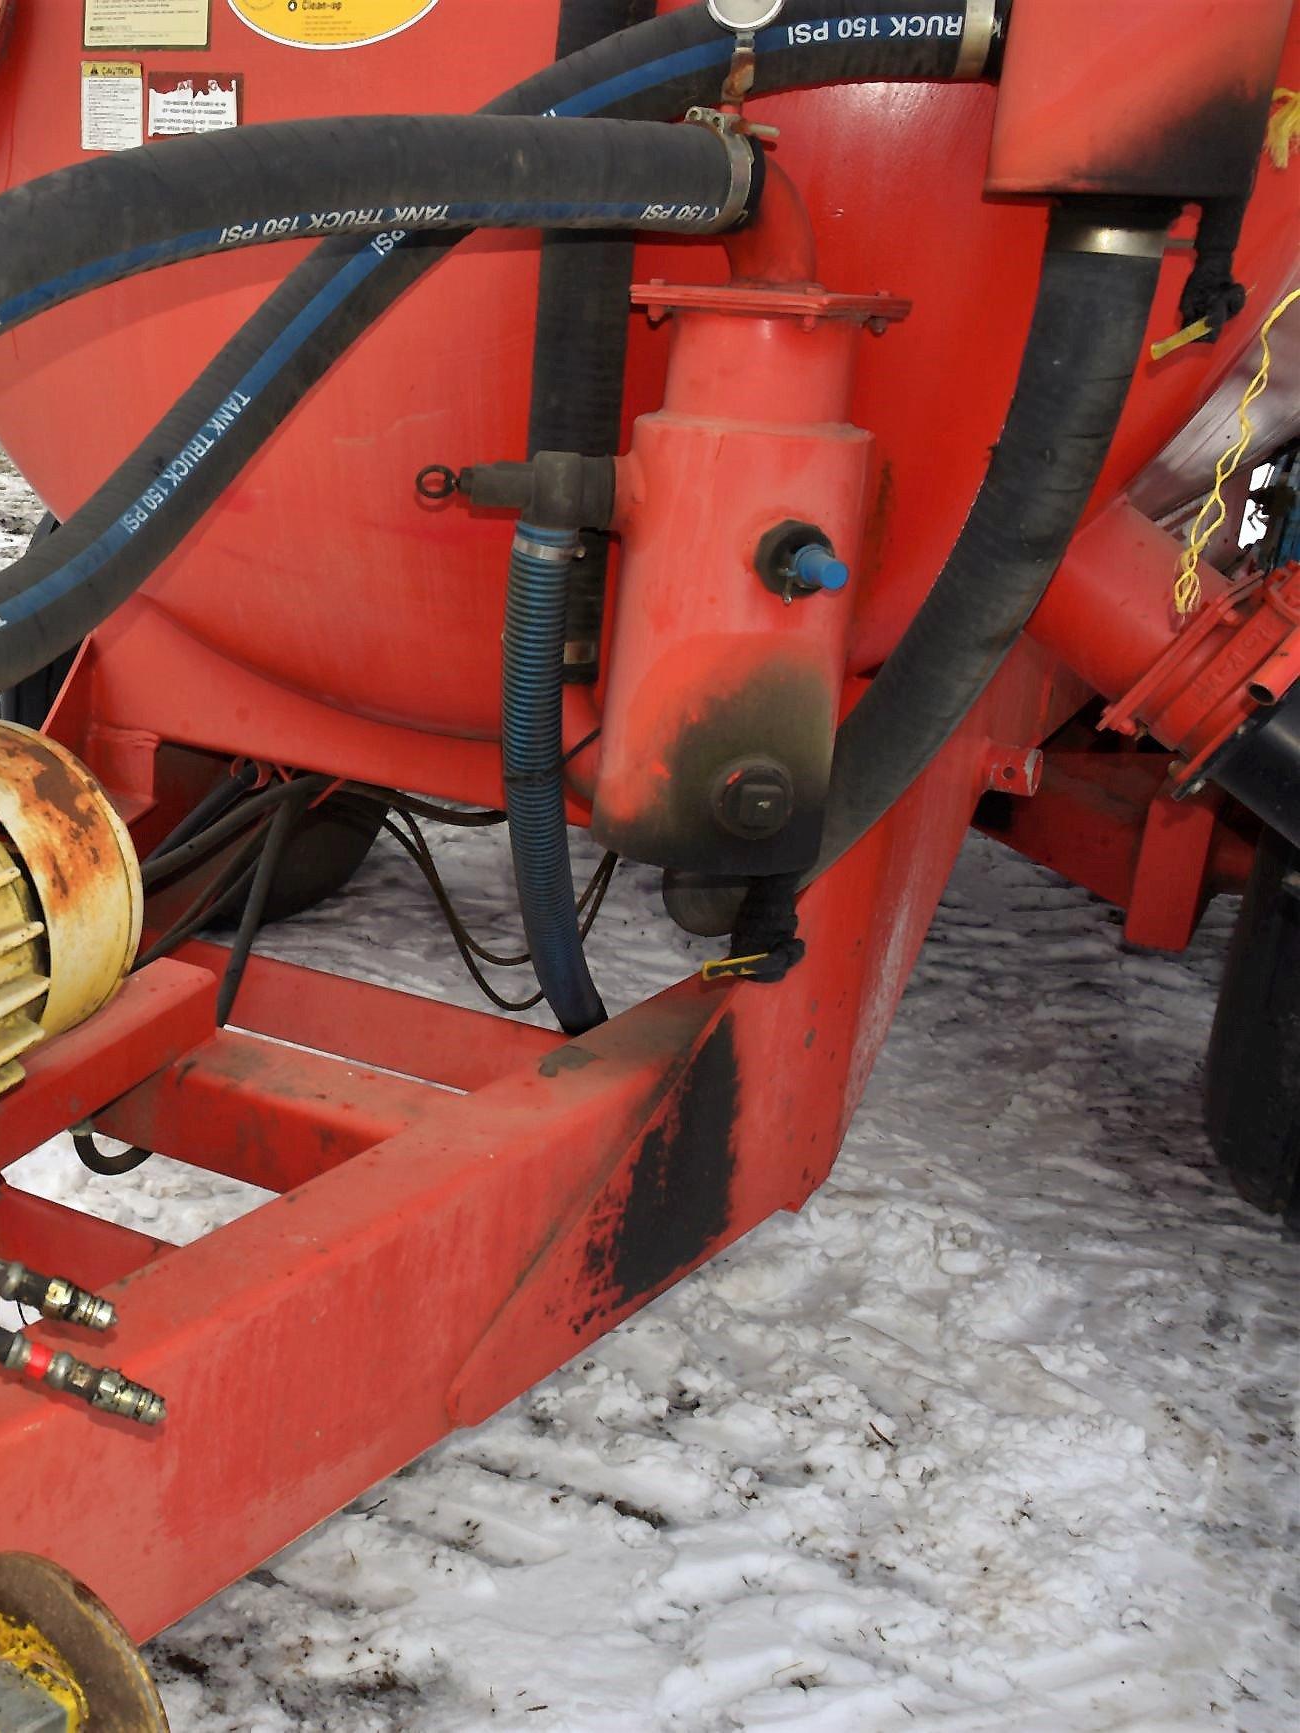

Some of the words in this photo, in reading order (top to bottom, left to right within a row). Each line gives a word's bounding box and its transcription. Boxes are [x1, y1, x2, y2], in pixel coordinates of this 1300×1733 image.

[787, 21, 829, 45] PSI
[838, 17, 880, 39] 150
[889, 15, 963, 37] RUCK
[307, 208, 384, 229] TRUCK
[389, 204, 450, 223] TANK
[640, 204, 676, 220] PSI
[676, 205, 707, 220] 150
[219, 222, 259, 245] PSI
[262, 215, 300, 236] 150
[207, 390, 251, 436] TANK
[160, 433, 215, 488] TRUCK
[143, 485, 169, 511] 150
[120, 504, 148, 534] PSI
